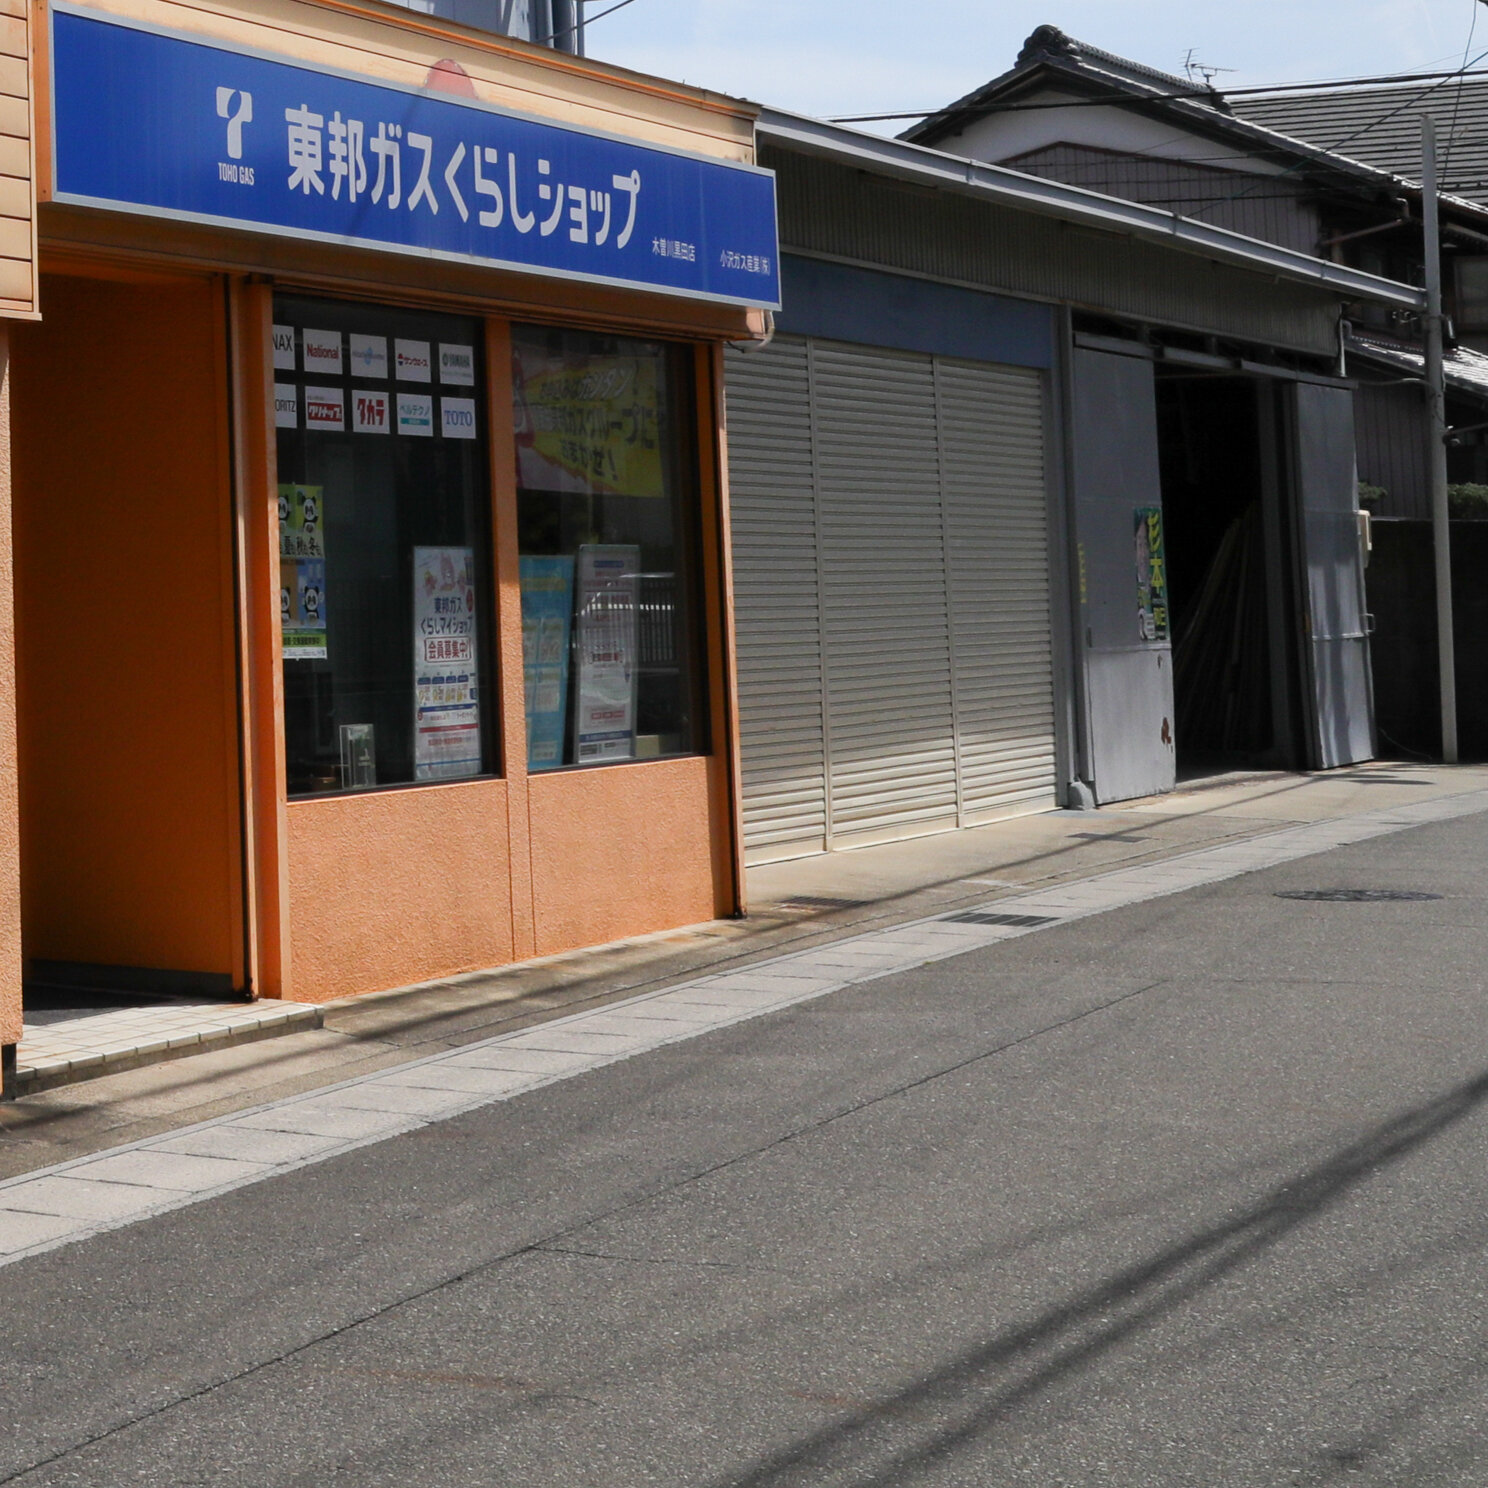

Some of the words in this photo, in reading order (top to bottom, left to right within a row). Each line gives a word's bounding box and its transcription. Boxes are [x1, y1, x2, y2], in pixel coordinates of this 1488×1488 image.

[218, 162, 238, 183] TOHO
[239, 166, 255, 186] GAS
[285, 103, 641, 250] 東邦ガスくらしショップ
[651, 236, 696, 262] 木曽川黒田店
[307, 344, 340, 360] National
[274, 399, 296, 413] ORITZ
[357, 398, 385, 426] タカラ
[444, 410, 473, 427] TOTO
[434, 596, 463, 614] 東邦ガス
[420, 615, 473, 635] くらしマイショップ
